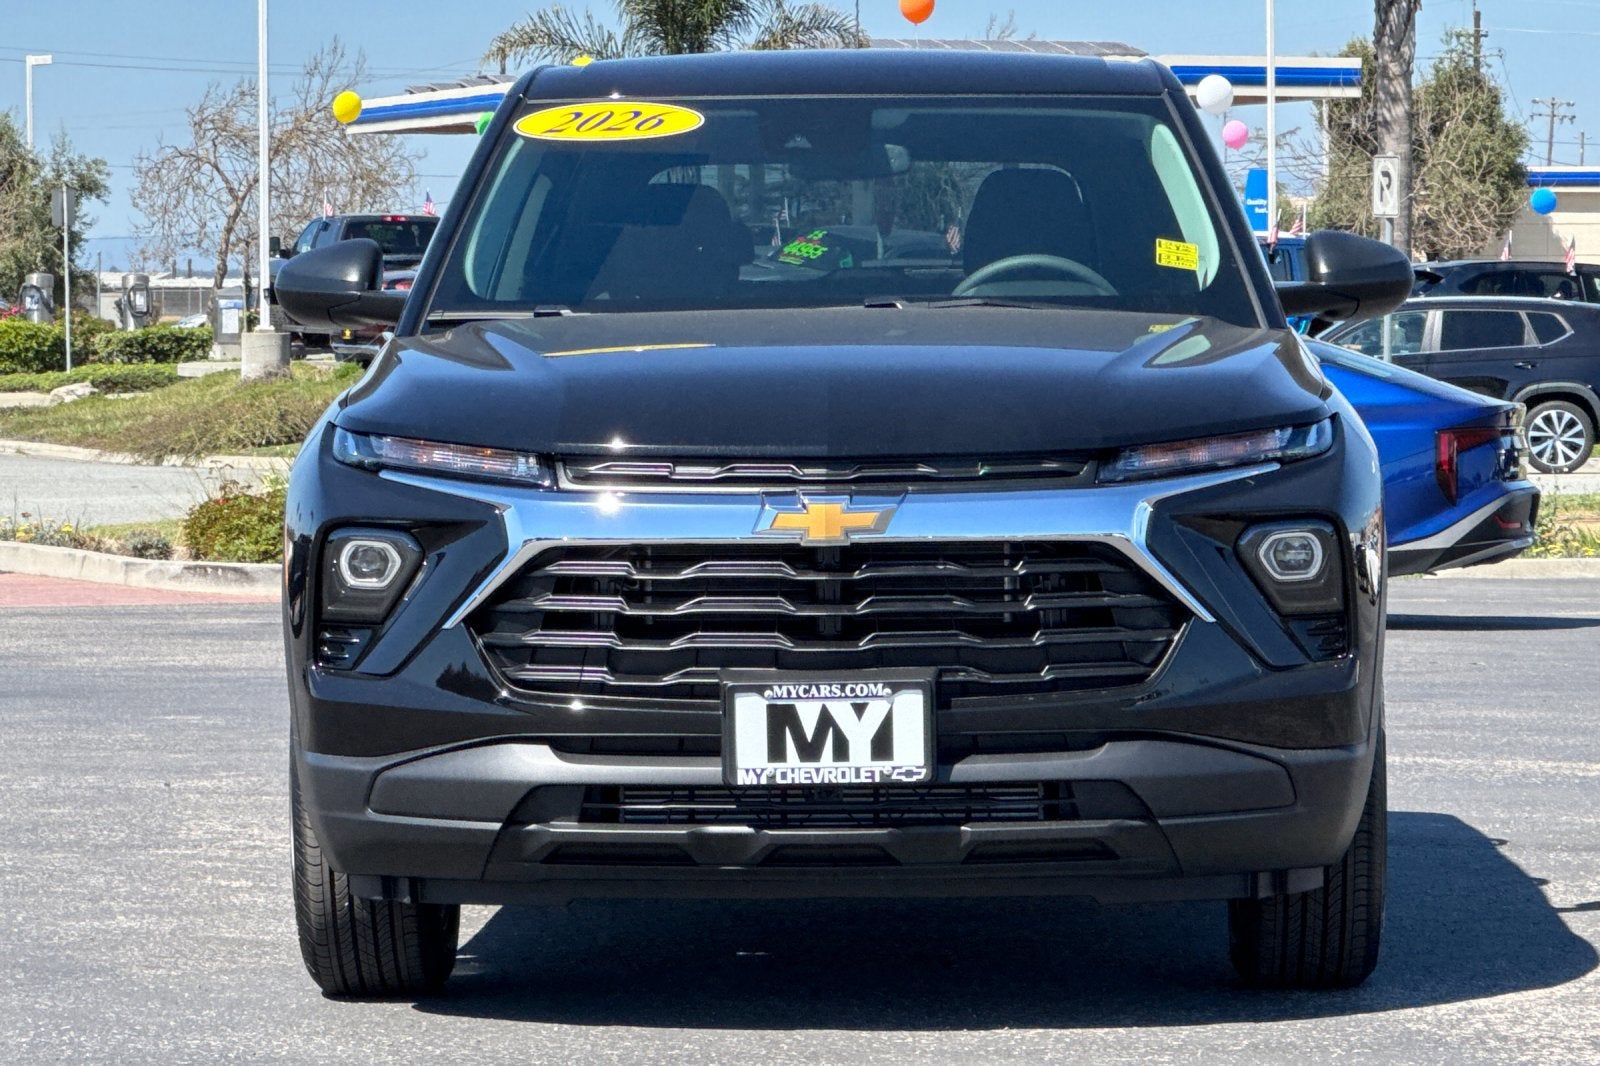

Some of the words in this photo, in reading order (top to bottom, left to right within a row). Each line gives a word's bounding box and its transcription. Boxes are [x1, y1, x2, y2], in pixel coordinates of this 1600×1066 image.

[541, 110, 679, 134] 2026
[772, 684, 884, 699] MYCARS.COM
[766, 702, 894, 763] MY
[737, 768, 767, 785] MY
[775, 767, 883, 784] CHEVROLET
